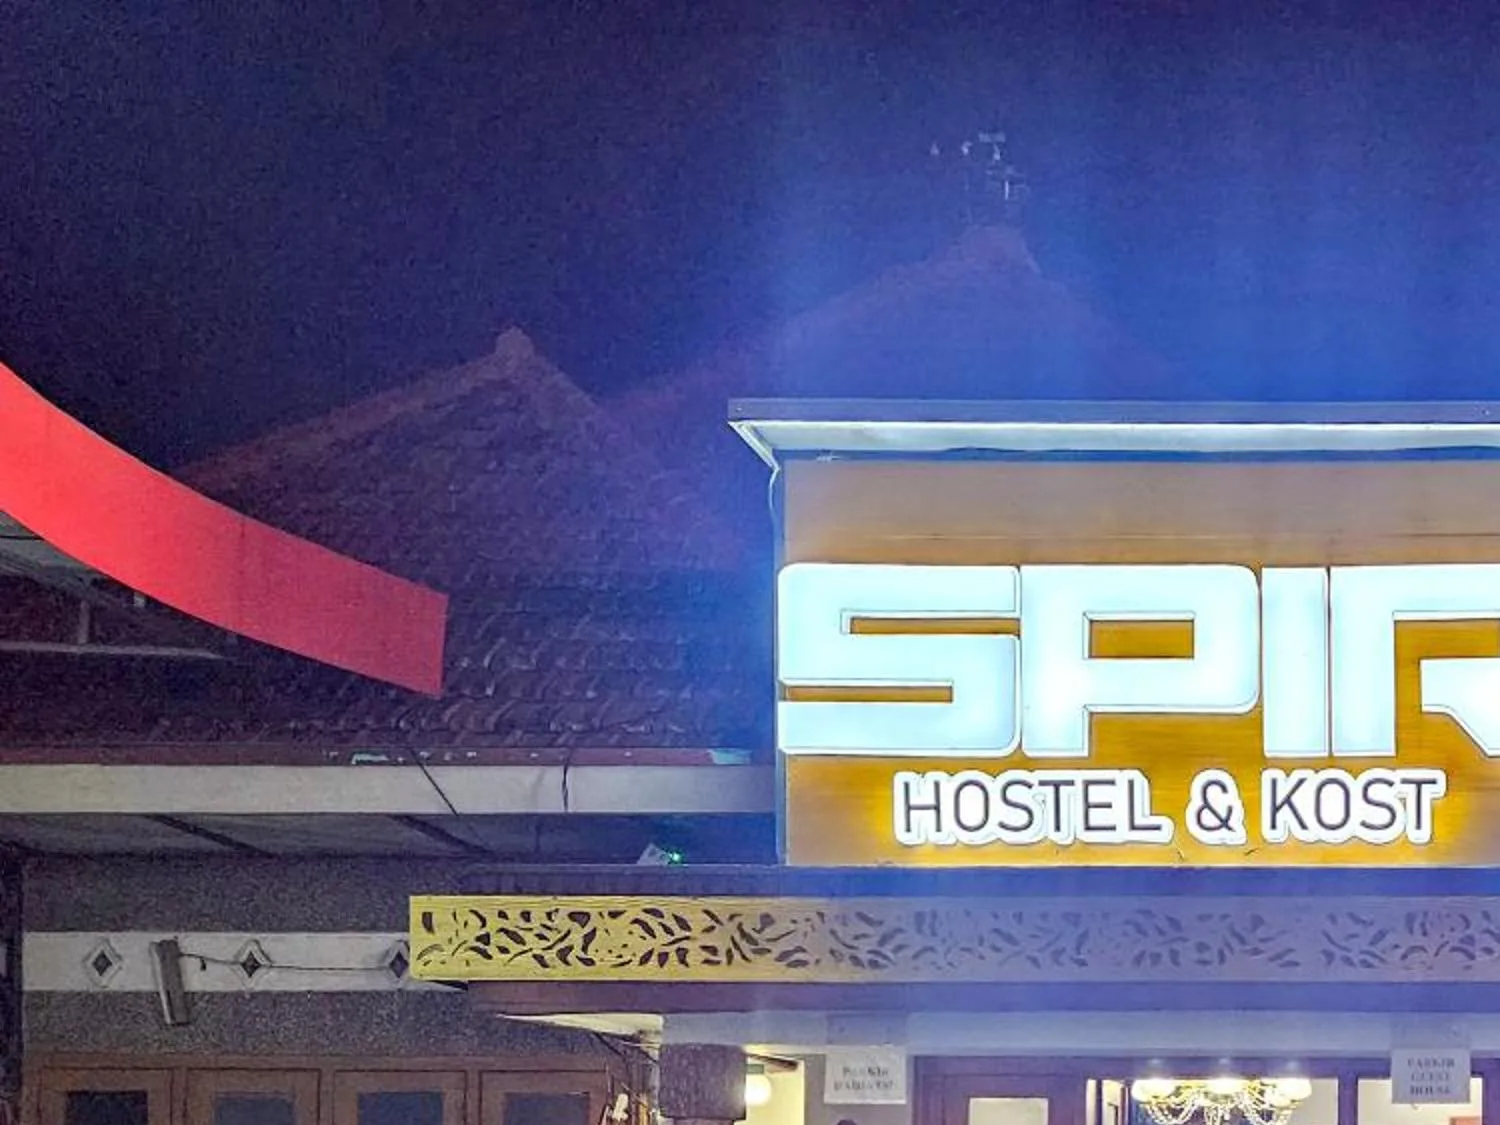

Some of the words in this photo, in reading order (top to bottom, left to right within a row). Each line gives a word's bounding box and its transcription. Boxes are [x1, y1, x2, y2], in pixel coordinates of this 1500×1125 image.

[902, 778, 1164, 834] HOSTEL
[1194, 778, 1237, 834] &
[1268, 776, 1439, 832] KOST
